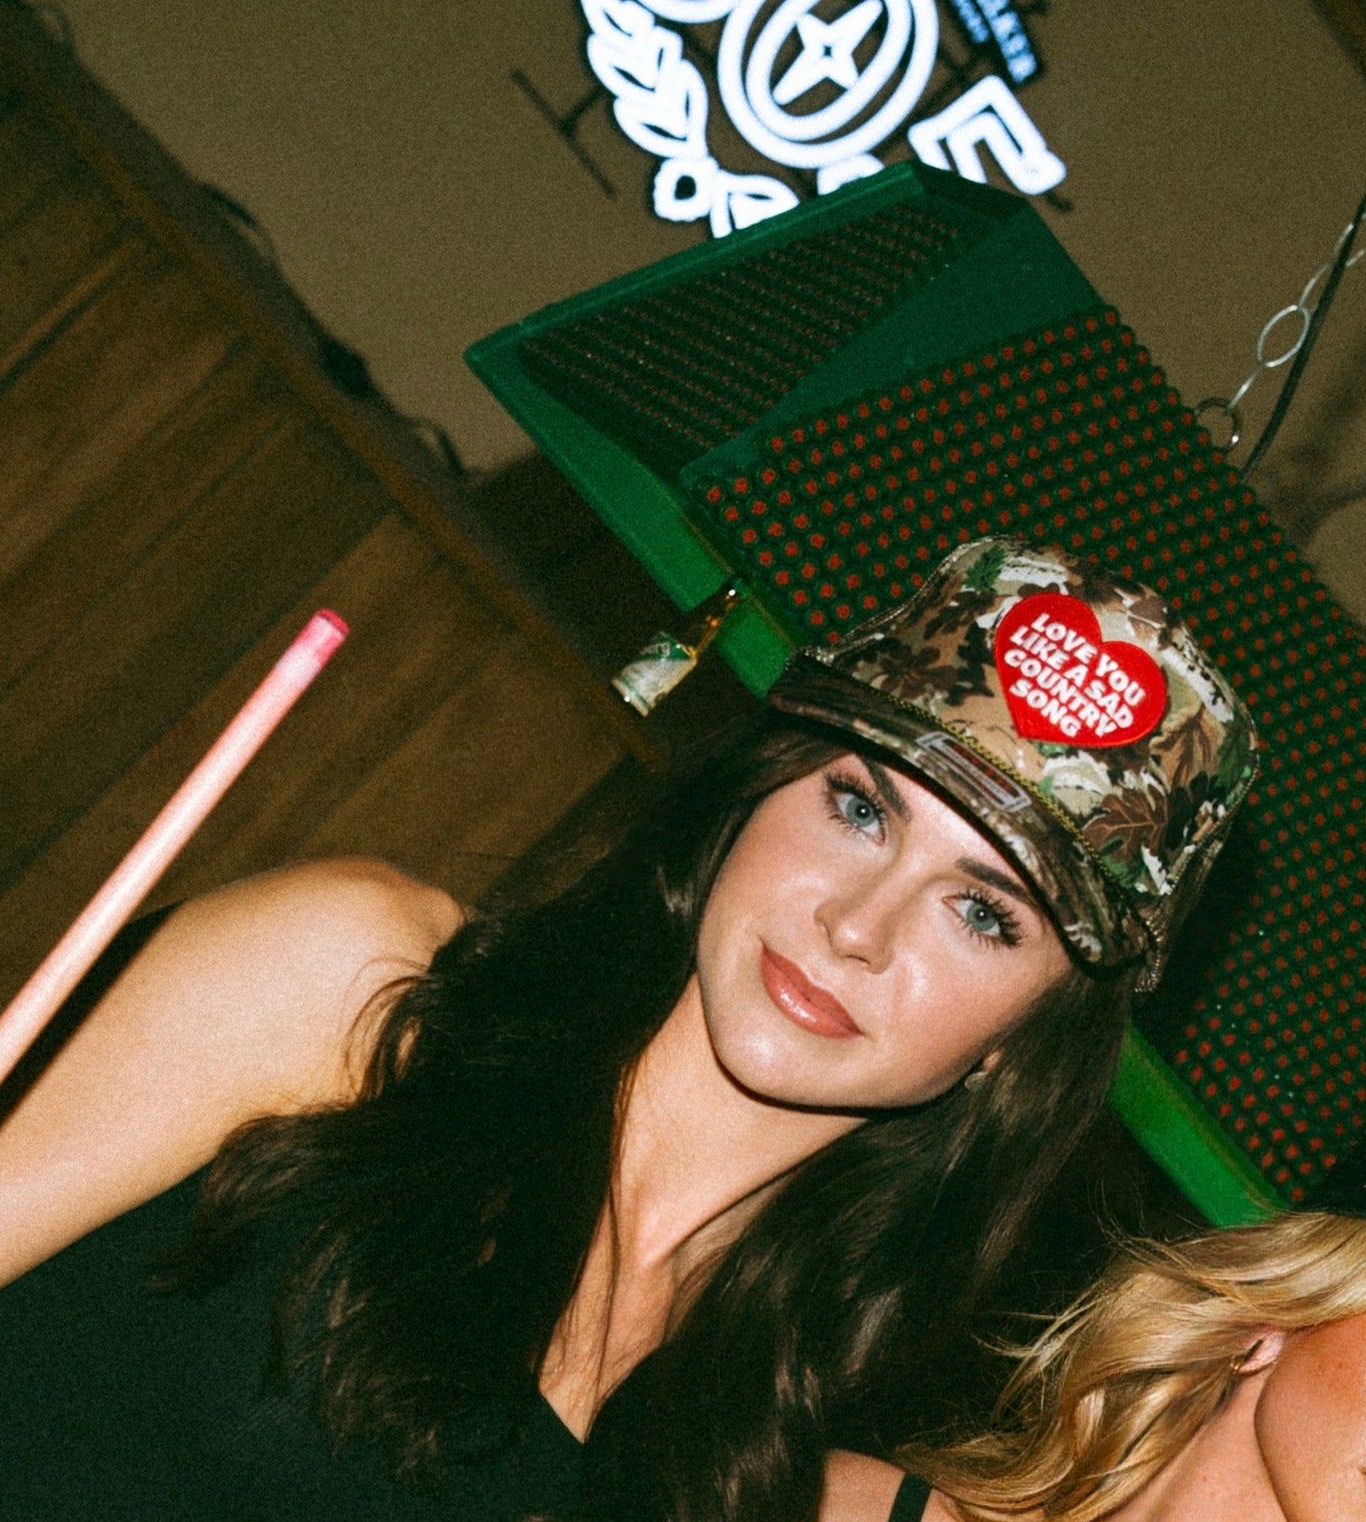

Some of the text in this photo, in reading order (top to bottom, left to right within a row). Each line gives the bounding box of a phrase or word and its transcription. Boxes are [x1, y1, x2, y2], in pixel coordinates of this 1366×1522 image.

[1004, 648, 1118, 737] COUNTRY
[1010, 626, 1134, 729] LIKE A SAD
[1031, 613, 1146, 707] LOVE YOU
[1009, 678, 1082, 738] SONG
